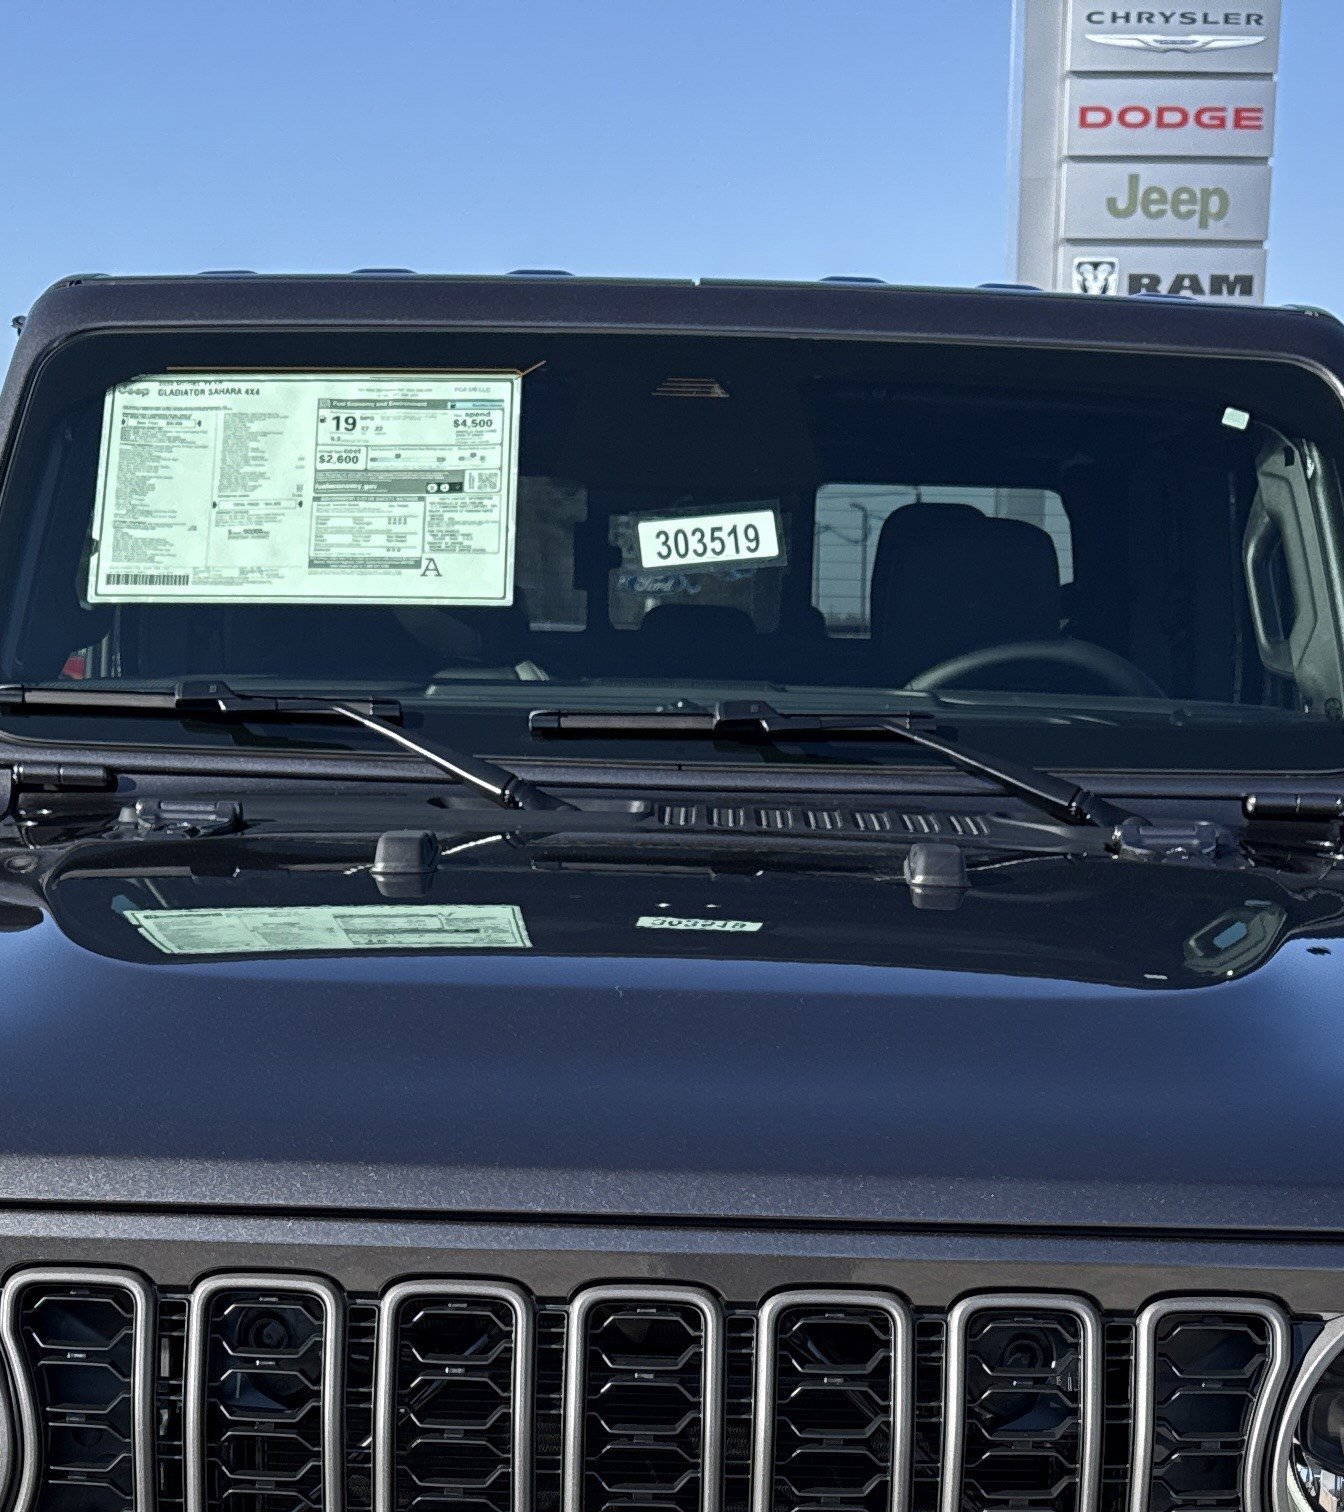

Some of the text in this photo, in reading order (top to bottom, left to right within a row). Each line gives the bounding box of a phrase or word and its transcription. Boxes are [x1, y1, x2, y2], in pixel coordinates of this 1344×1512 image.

[1086, 11, 1264, 26] CHRYSLER
[1078, 105, 1264, 130] DODGE
[1106, 173, 1230, 229] Jeep
[1128, 273, 1254, 296] RAM
[157, 388, 206, 397] GLADIATOR
[208, 387, 242, 396] SAHARA
[331, 416, 357, 432] 19
[453, 419, 493, 429] $4,500
[318, 454, 359, 464] $2,600
[655, 523, 760, 560] 303519
[420, 557, 442, 577] A
